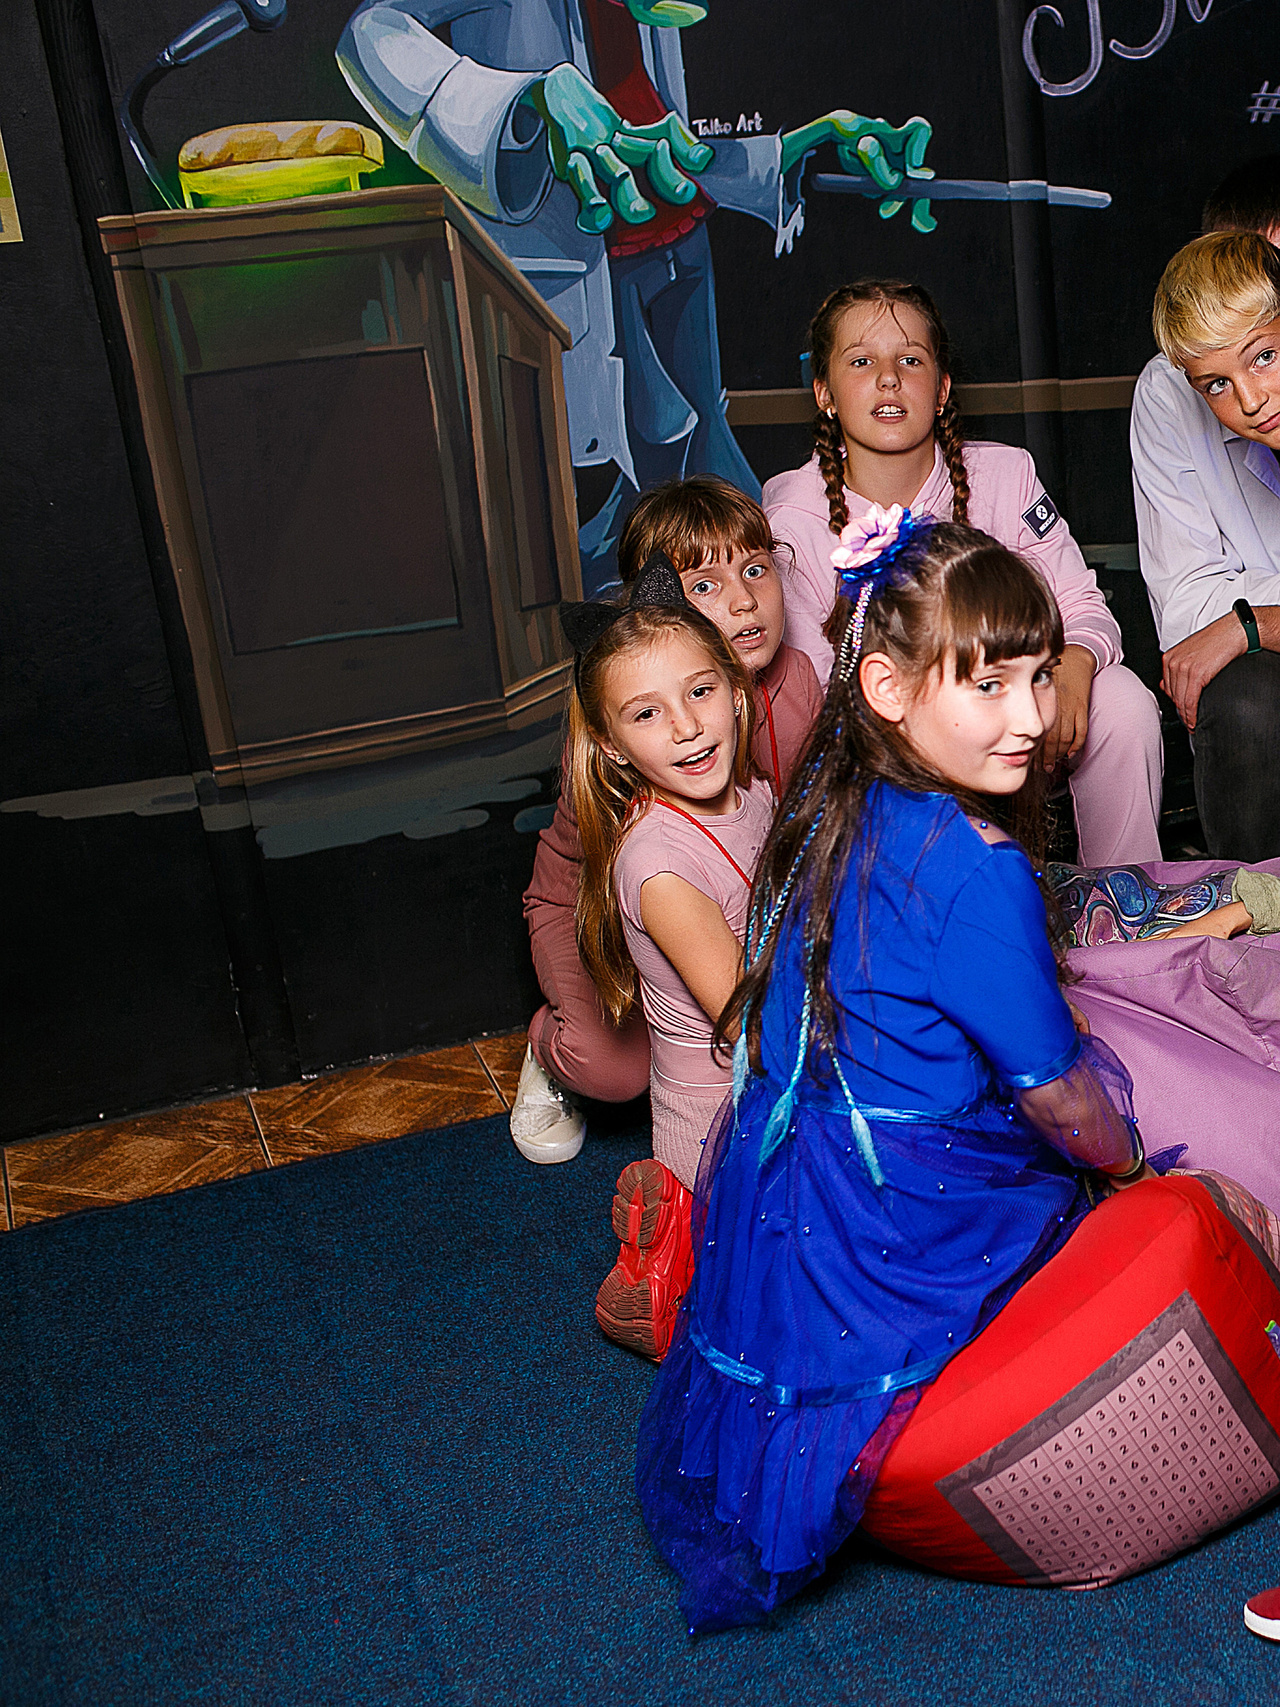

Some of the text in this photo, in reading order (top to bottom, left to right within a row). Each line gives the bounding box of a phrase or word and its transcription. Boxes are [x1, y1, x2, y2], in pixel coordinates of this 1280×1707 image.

[736, 111, 763, 132] Art
[984, 1340, 1185, 1495] 1 2 7 4 2 3 6 8 9 3
[995, 1357, 1195, 1510] 2 3 5 8 7 3 2 7 5 4
[1005, 1513, 1016, 1523] 3
[1053, 1490, 1063, 1500] 8
[1075, 1475, 1083, 1486] 7
[1097, 1460, 1107, 1472] 3
[1119, 1444, 1129, 1456] 2
[1140, 1427, 1148, 1439] 7
[1161, 1411, 1169, 1422] 4
[1179, 1392, 1189, 1404] 3
[1197, 1374, 1206, 1385] 8
[1040, 1515, 1050, 1525] 2
[1062, 1503, 1073, 1514] 3
[1086, 1489, 1095, 1501] 5
[1109, 1475, 1117, 1486] 4
[1131, 1460, 1139, 1470] 6
[1151, 1443, 1160, 1454] 8
[1169, 1426, 1177, 1437] 7
[1189, 1408, 1197, 1418] 9
[1207, 1390, 1216, 1402] 2
[1095, 1504, 1105, 1514] 8
[1117, 1489, 1127, 1500] 3
[1140, 1474, 1149, 1485] 5
[1161, 1458, 1170, 1468] 4
[1180, 1441, 1189, 1452] 8
[1199, 1422, 1208, 1434] 5
[1217, 1405, 1225, 1415] 4
[1082, 1529, 1091, 1538] 3
[1106, 1517, 1114, 1526] 4
[1127, 1503, 1136, 1513] 3
[1149, 1487, 1158, 1498] 5
[1171, 1472, 1179, 1481] 6
[1189, 1455, 1198, 1466] 3
[1209, 1437, 1217, 1447] 4
[1226, 1419, 1234, 1429] 6
[1115, 1529, 1123, 1538] 6
[1136, 1515, 1145, 1525] 5
[1158, 1500, 1165, 1510] 7
[1179, 1485, 1187, 1494] 9
[1198, 1468, 1207, 1479] 8
[1218, 1450, 1226, 1461] 4
[1234, 1432, 1242, 1444] 3
[1123, 1540, 1132, 1549] 4
[1167, 1513, 1175, 1522] 8
[1187, 1496, 1196, 1507] 5
[1206, 1481, 1216, 1491] 2
[1226, 1463, 1233, 1472] 9
[1243, 1445, 1251, 1456] 8
[1152, 1538, 1160, 1547] 7
[1251, 1457, 1257, 1467] 7
[1265, 1480, 1271, 1489] 7
